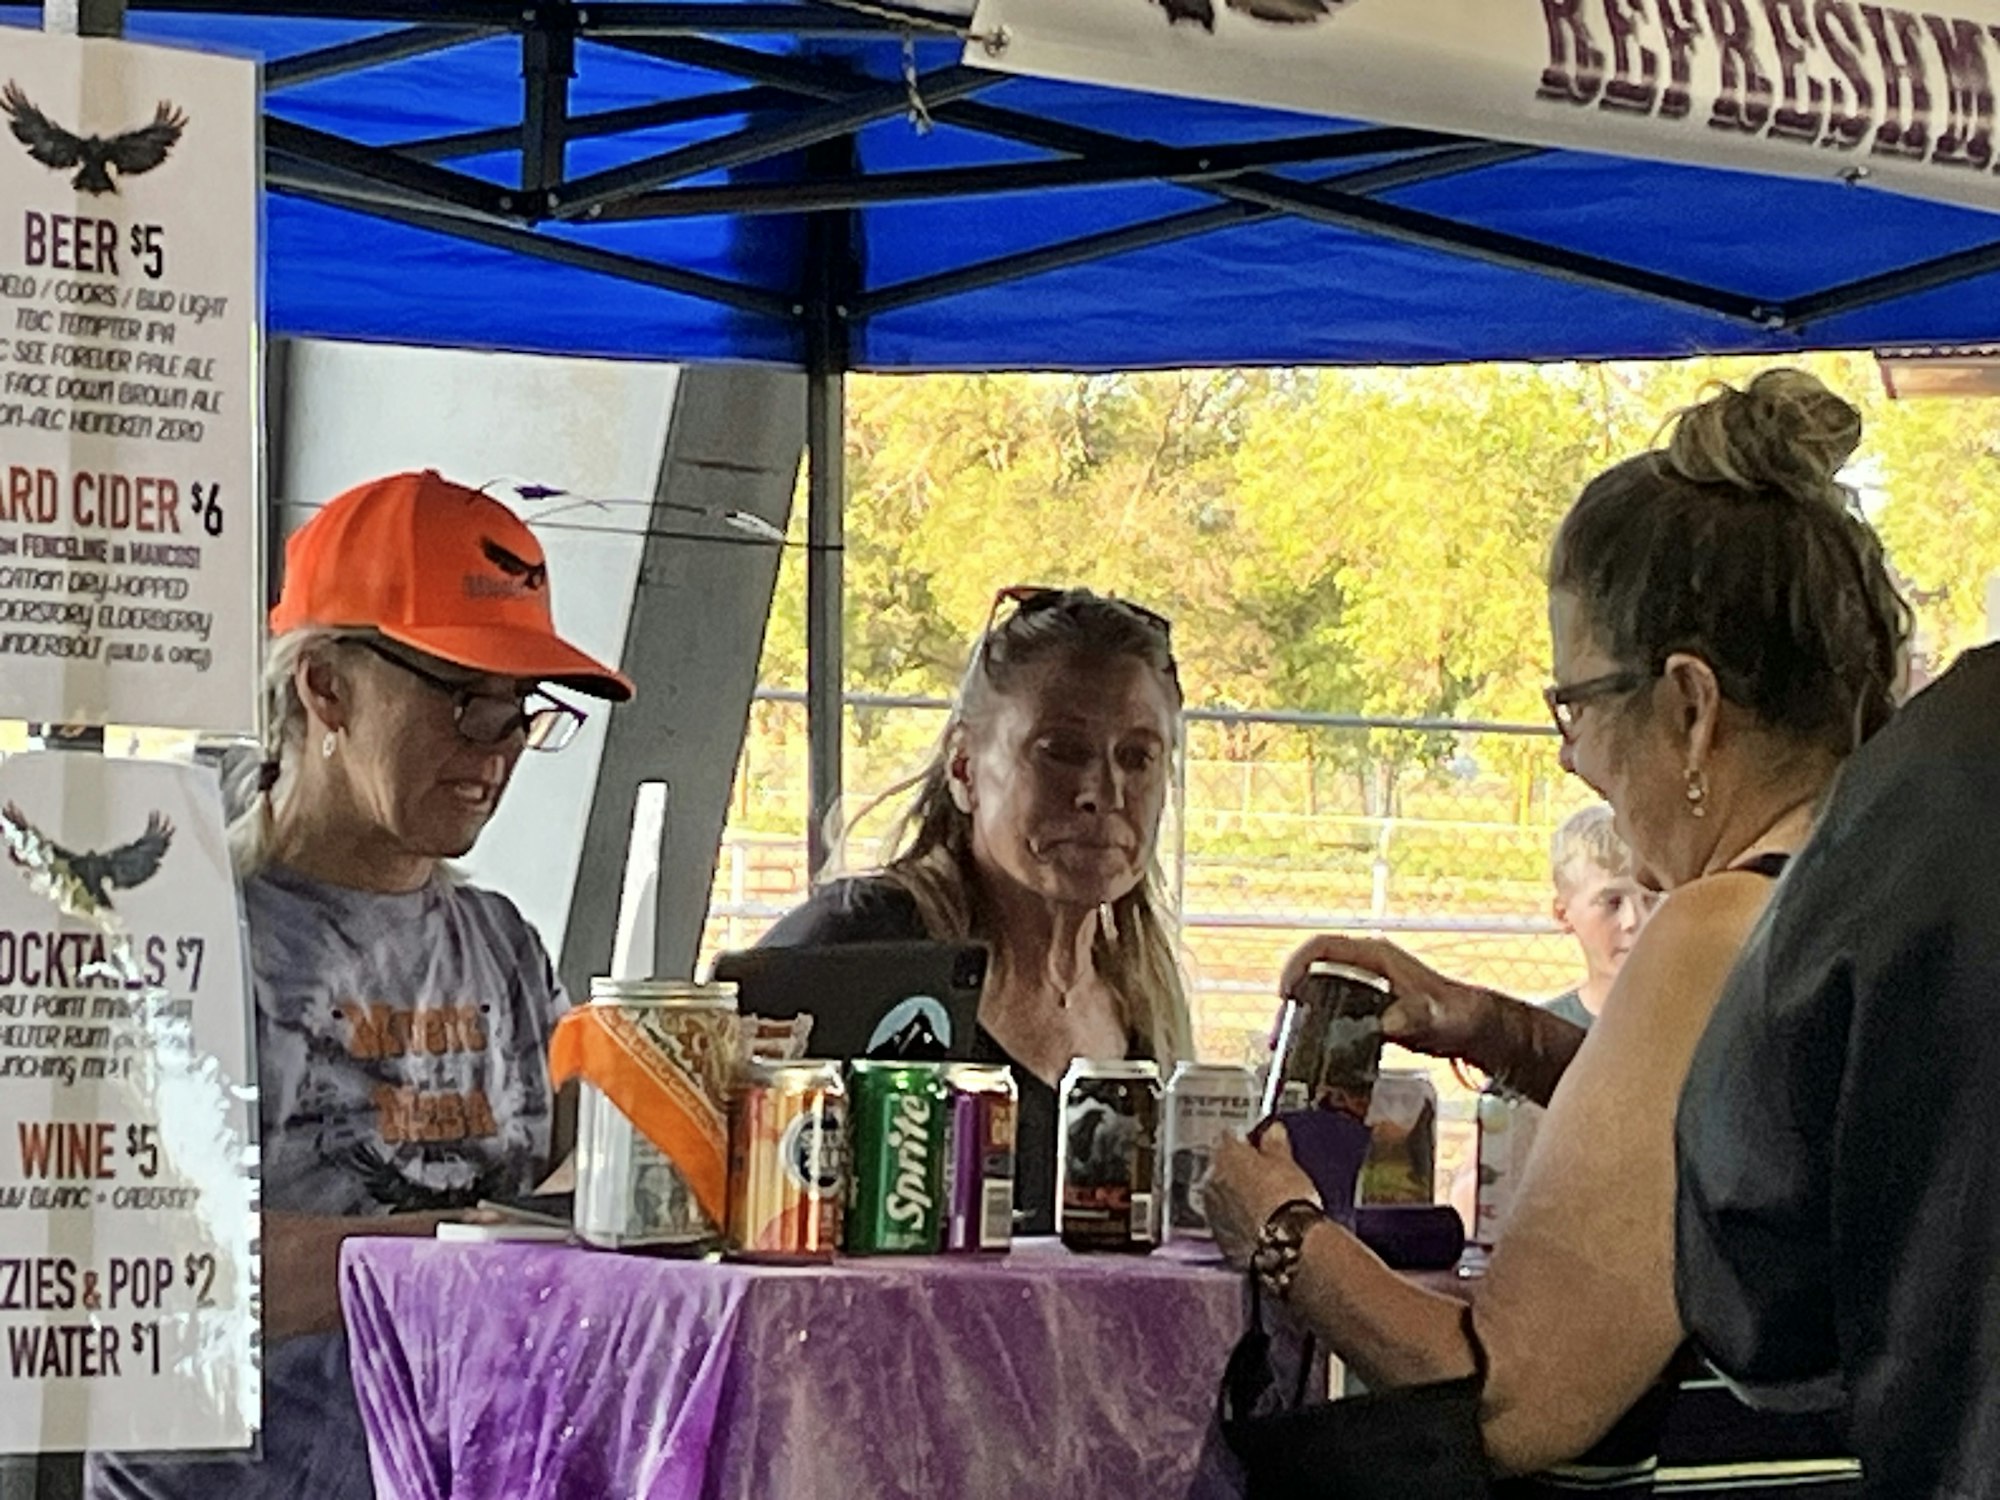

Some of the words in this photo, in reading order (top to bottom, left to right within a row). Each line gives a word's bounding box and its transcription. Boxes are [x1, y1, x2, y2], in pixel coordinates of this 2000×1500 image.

[1535, 0, 2000, 171] REFRESHM
[25, 211, 119, 275] BEER
[130, 223, 165, 279] $5
[55, 280, 117, 308] COORS
[136, 287, 175, 314] BUD
[179, 293, 229, 325] LIGHT
[13, 340, 48, 365] SEE
[51, 343, 133, 373] FOREVER
[136, 351, 182, 378] PALE
[182, 356, 217, 382] ALE
[5, 371, 53, 398] FACE
[118, 381, 189, 408] BROWN
[191, 389, 225, 415] ALE
[156, 416, 205, 444] ZERO
[0, 464, 59, 525] RD
[72, 471, 181, 534] CIDER
[191, 481, 224, 537] $6
[176, 936, 205, 992] $7
[18, 1121, 117, 1180] WINE
[126, 1123, 158, 1178] $5
[886, 1094, 934, 1232] Sprite
[83, 1270, 103, 1311] &
[108, 1256, 174, 1310] POP
[185, 1252, 216, 1310] $2
[8, 1324, 122, 1379] WATER
[131, 1320, 161, 1375] $1
